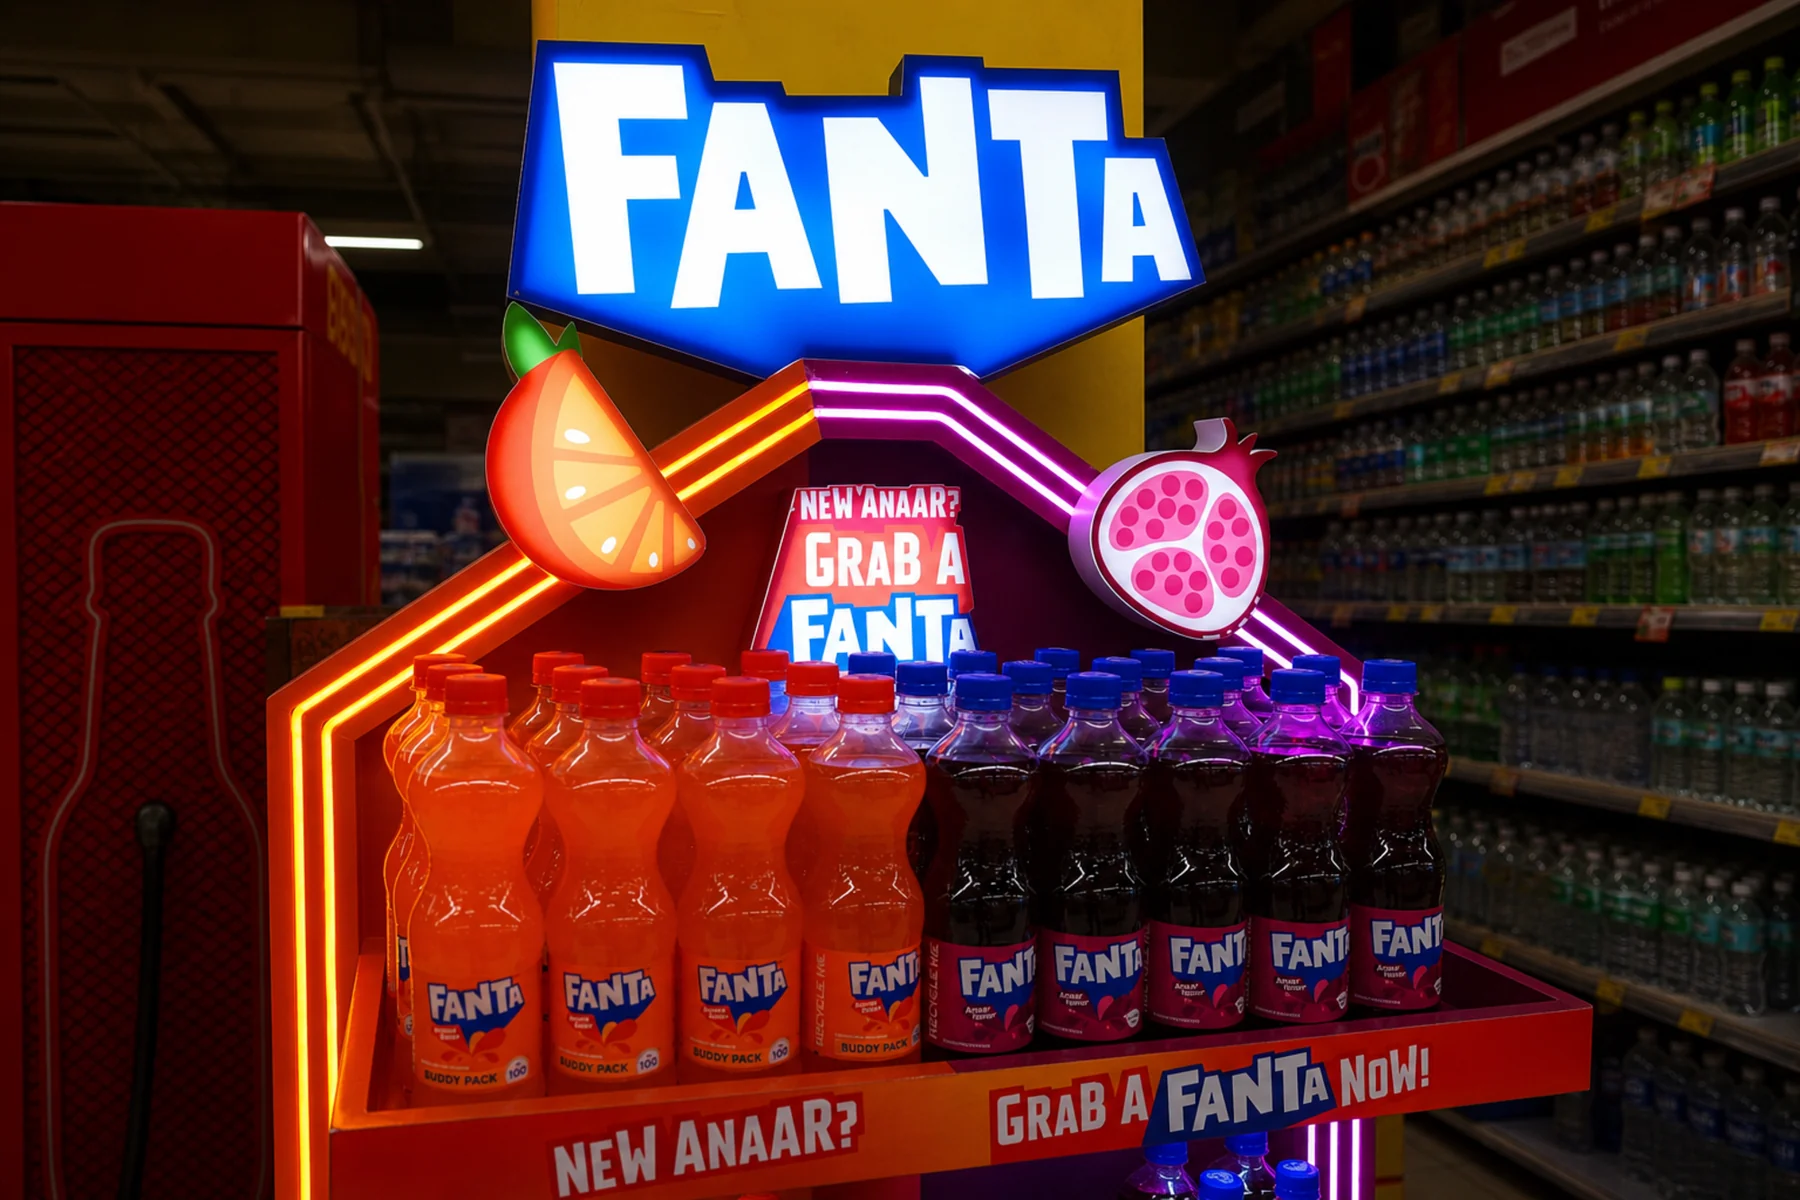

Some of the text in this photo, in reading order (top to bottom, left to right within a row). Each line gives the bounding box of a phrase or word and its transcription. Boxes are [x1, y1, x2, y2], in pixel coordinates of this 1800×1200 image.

[552, 62, 1192, 309] FANTA
[801, 486, 960, 520] NEW ANAAR?
[805, 532, 965, 587] GRAB A
[790, 597, 977, 664] FANTA
[1054, 940, 1142, 984] FANTA
[1271, 926, 1349, 970] FANTA
[428, 978, 524, 1022] FANTA
[564, 970, 656, 1011] FANTA
[699, 961, 787, 1003] FANTA
[560, 1056, 628, 1074] BUDDY PACK
[640, 1056, 658, 1070] 100
[693, 1046, 762, 1064] BUDDY PACK
[772, 1046, 788, 1060] 100
[841, 1038, 908, 1054] BUDDY PACK
[424, 1069, 497, 1086] BUDDY PACK
[508, 1065, 527, 1080] 100
[997, 1044, 1430, 1146] GRAB A FANTA NOW!
[553, 1098, 858, 1198] NEW ANAAR?
